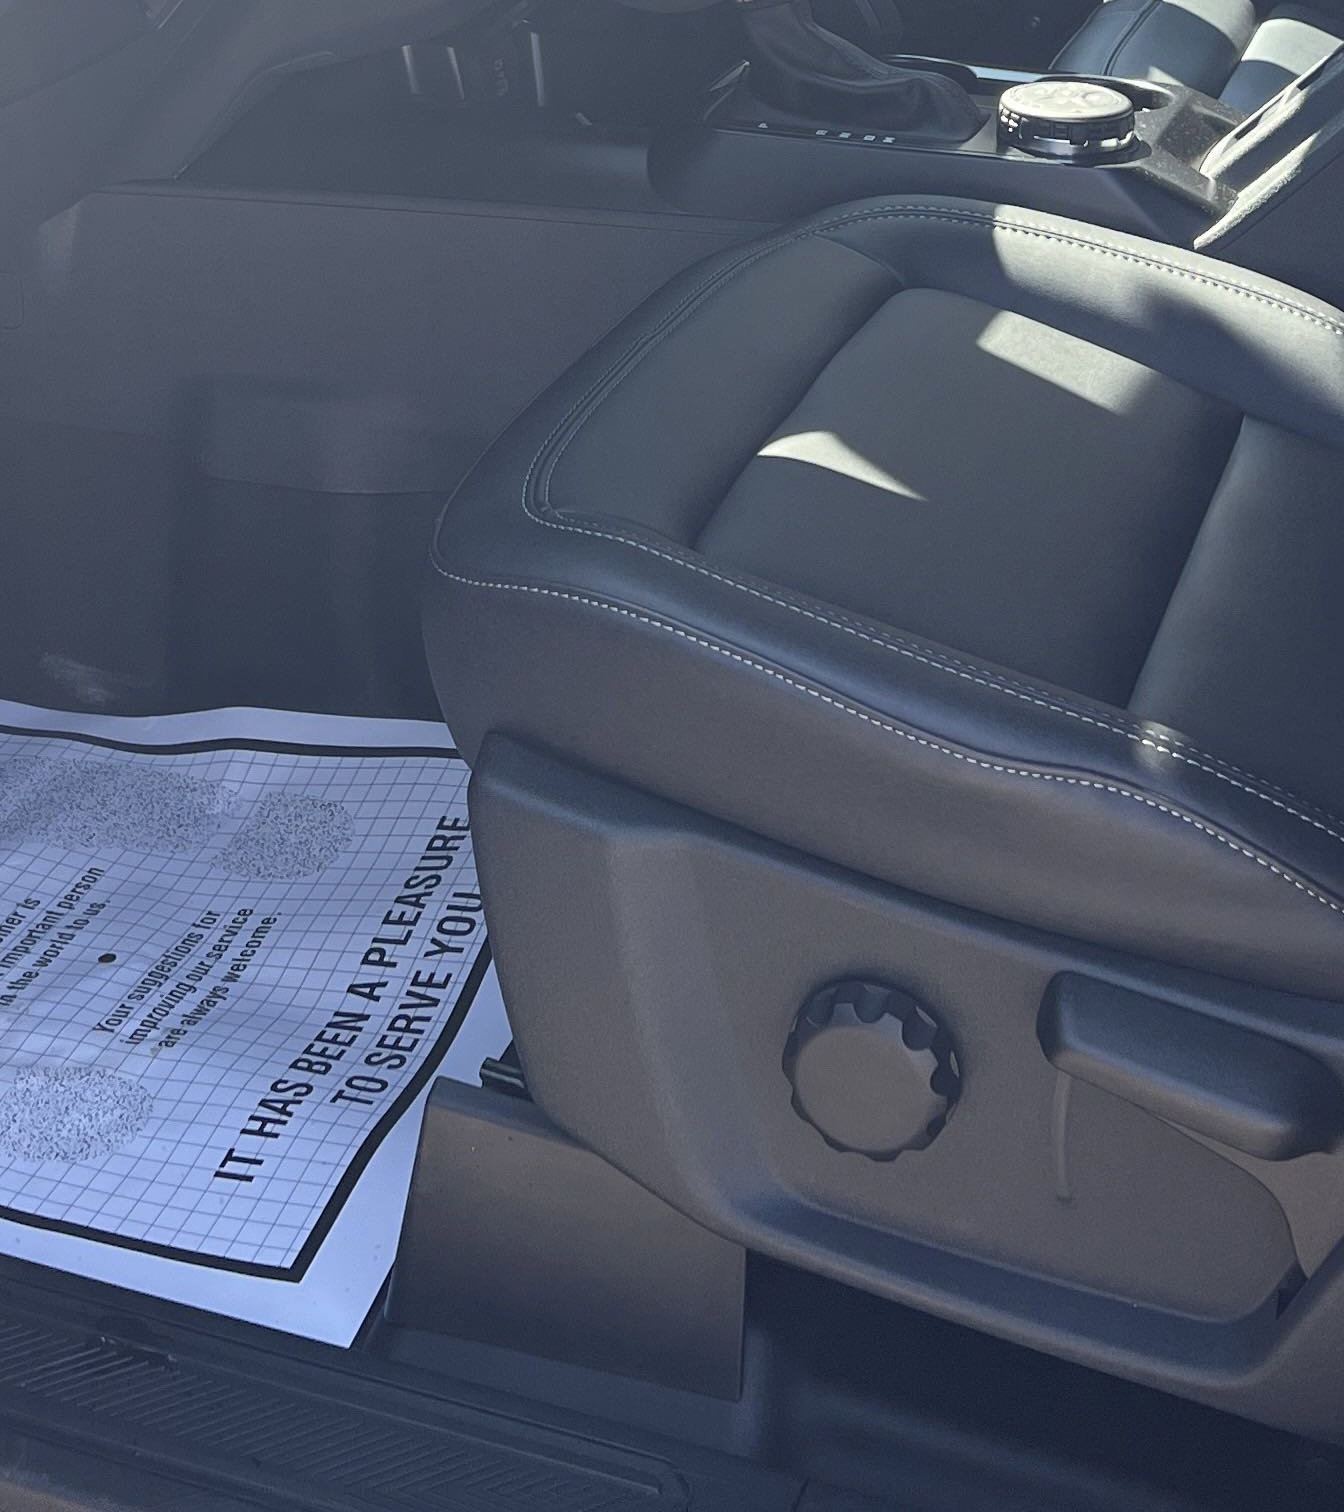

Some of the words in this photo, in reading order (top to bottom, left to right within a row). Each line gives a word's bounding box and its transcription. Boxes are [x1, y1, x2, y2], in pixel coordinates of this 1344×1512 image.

[16, 897, 41, 911] is
[57, 866, 105, 910] person
[359, 814, 471, 970] PLEASURE
[6, 969, 40, 991] the
[31, 931, 76, 969] world
[65, 917, 90, 931] to
[83, 899, 111, 918] us.
[92, 1003, 134, 1034] Your
[127, 931, 204, 1001] suggestions
[191, 910, 222, 930] for
[120, 982, 197, 1046] improving
[185, 960, 214, 983] our
[206, 908, 254, 961] service
[158, 1026, 188, 1049] are
[180, 985, 230, 1027] always
[221, 912, 283, 984] welcome.
[329, 1075, 390, 1106] TO
[364, 969, 453, 1071] SERVE
[423, 891, 484, 959] YOU
[346, 980, 389, 1003] A
[288, 1010, 372, 1076] BEEN
[239, 1078, 315, 1140] HAS
[213, 1147, 265, 1184] IT
